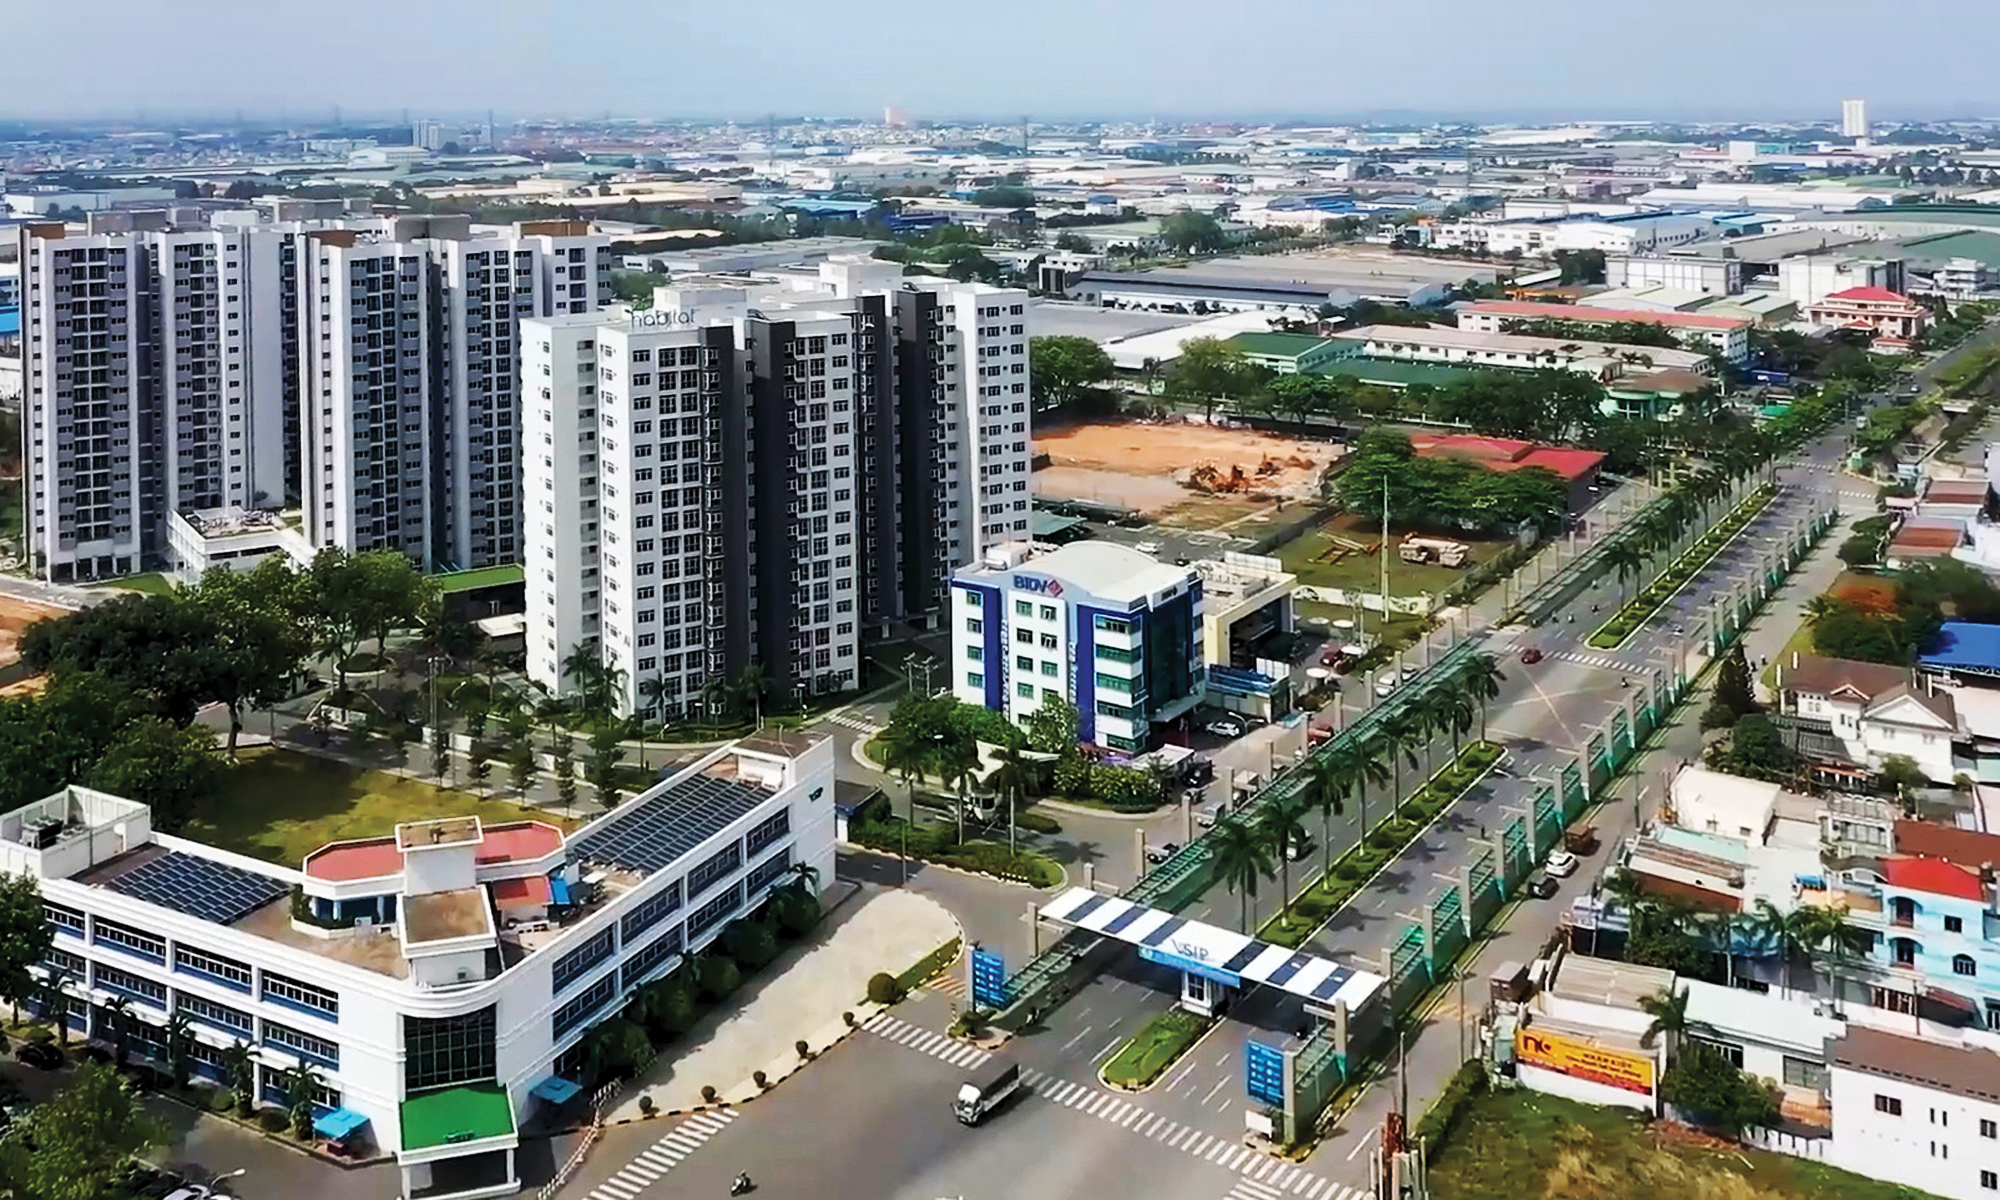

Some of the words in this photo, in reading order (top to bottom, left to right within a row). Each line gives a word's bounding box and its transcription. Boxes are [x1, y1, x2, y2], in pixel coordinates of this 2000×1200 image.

[632, 309, 697, 328] habitat
[1014, 575, 1048, 593] BIDV
[1171, 939, 1209, 960] VSIP
